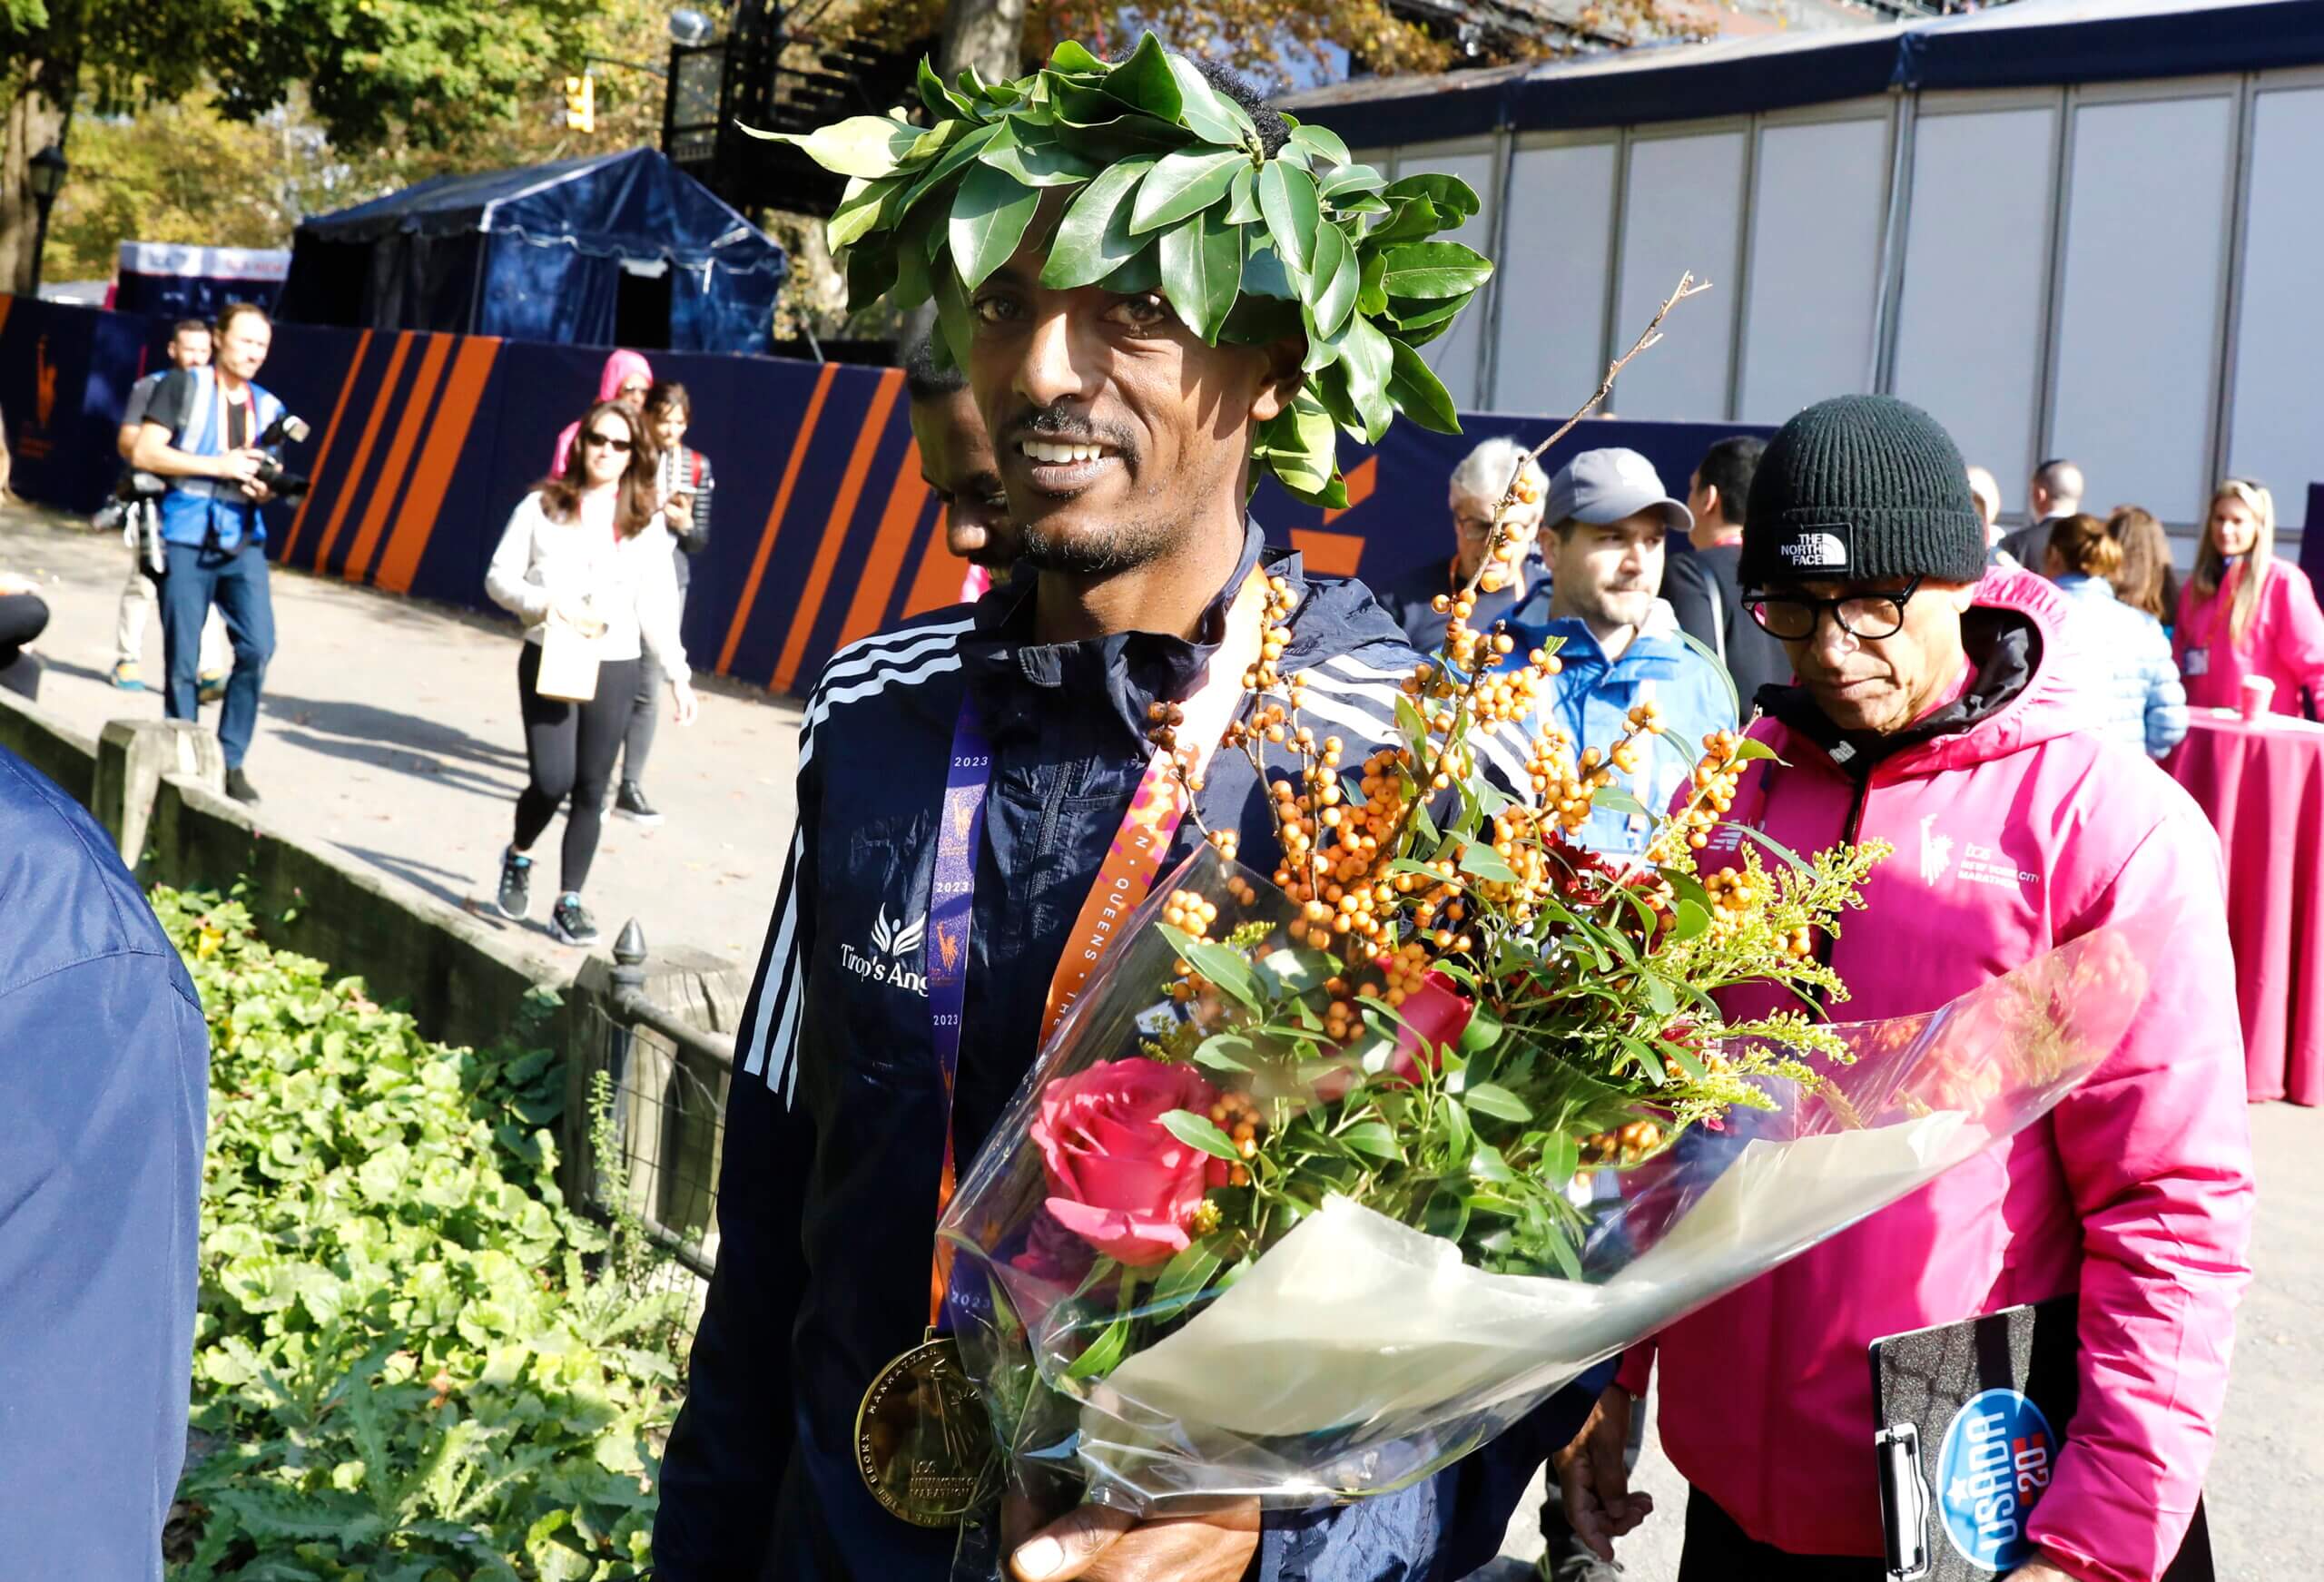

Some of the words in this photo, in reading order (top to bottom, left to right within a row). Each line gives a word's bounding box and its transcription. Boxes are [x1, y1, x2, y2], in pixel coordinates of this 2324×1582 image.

[1797, 533, 1822, 545] THE
[1780, 545, 1822, 555] NORTH
[1792, 555, 1822, 565] FACE
[954, 756, 989, 767] 2023
[2019, 870, 2041, 884] CITY
[936, 881, 969, 893] 2023
[1085, 878, 1129, 960] QUEENS
[841, 943, 886, 982] Tirop's
[933, 1014, 959, 1026] 2023
[862, 1432, 879, 1484] BRONX
[1966, 1411, 2019, 1551] USADA
